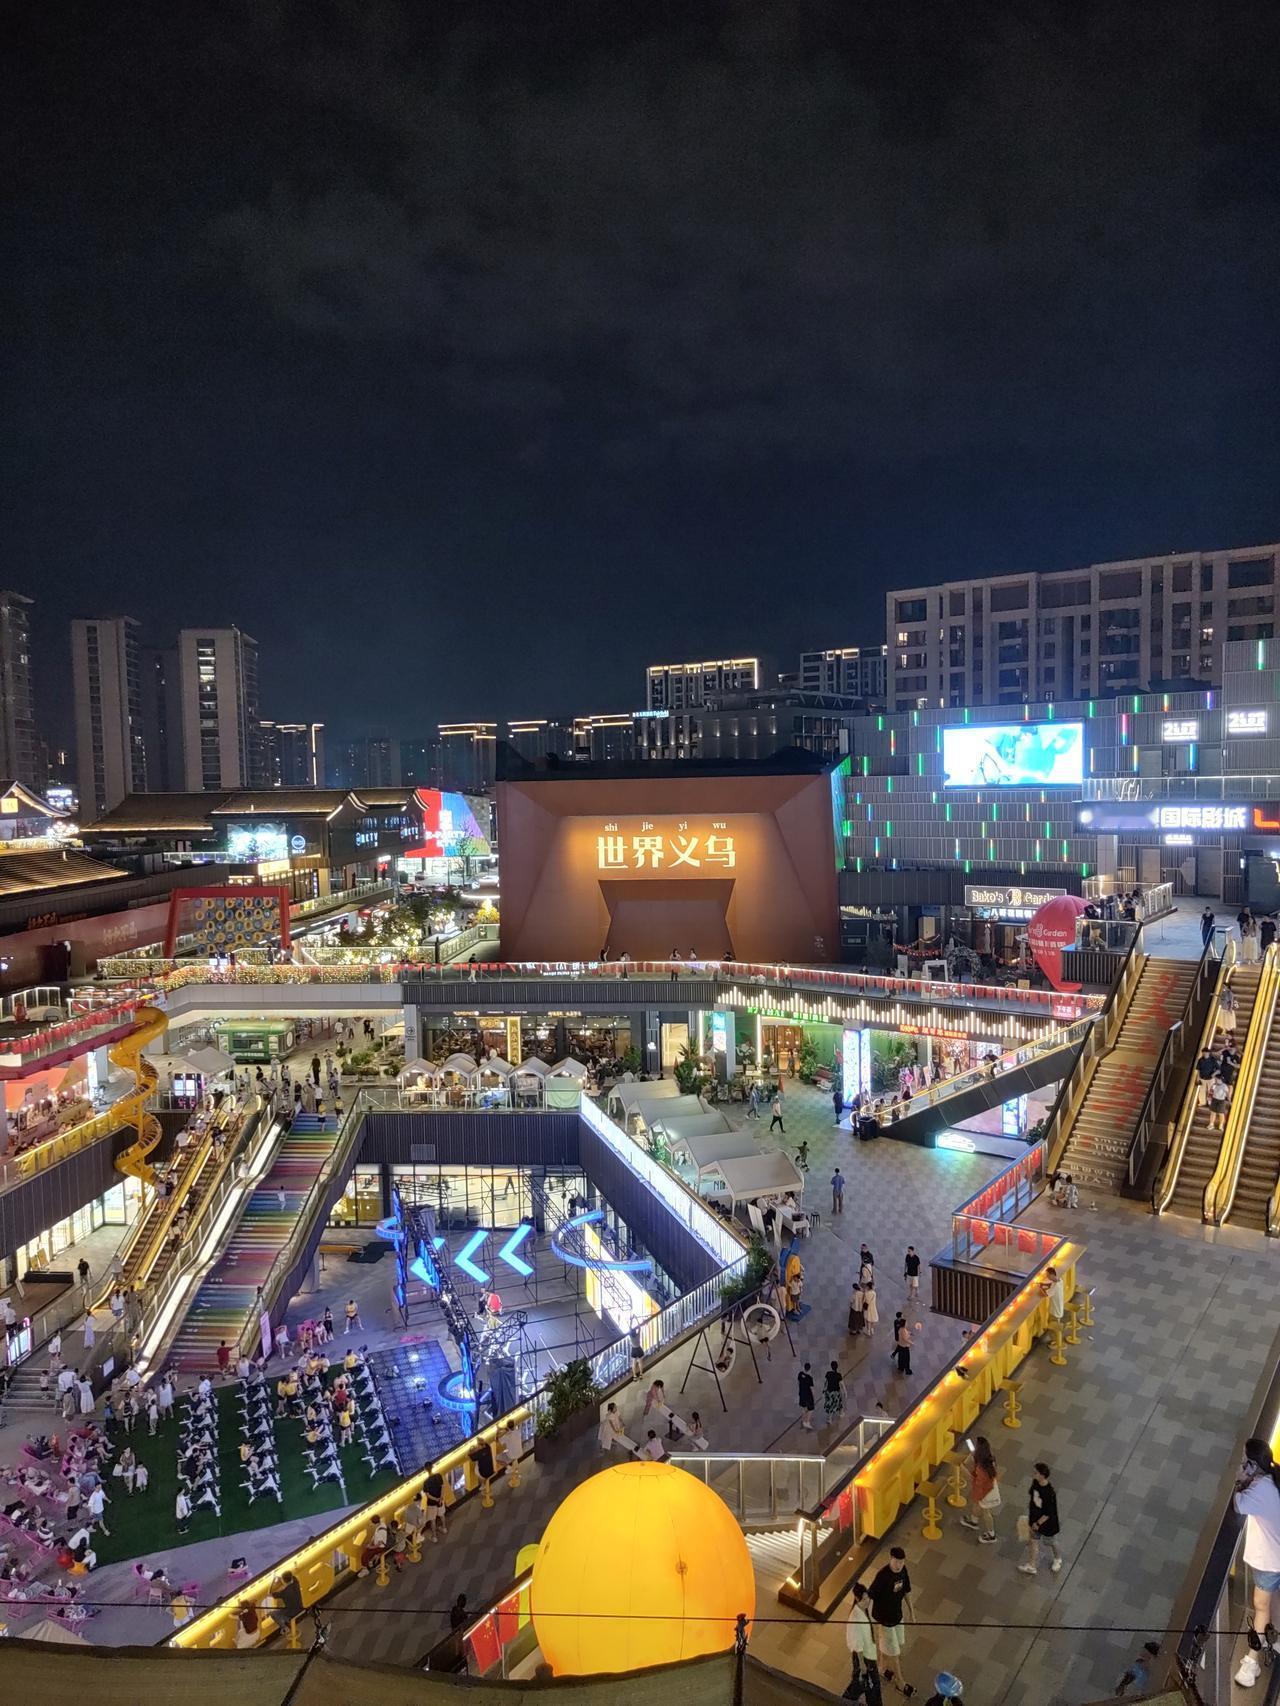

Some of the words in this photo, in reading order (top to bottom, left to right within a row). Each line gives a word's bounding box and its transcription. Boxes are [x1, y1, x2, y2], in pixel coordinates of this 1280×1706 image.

[604, 823, 618, 832] shi
[641, 821, 654, 832] jie
[679, 821, 688, 831] yi
[712, 821, 727, 829] wu
[596, 834, 736, 869] 世界义乌
